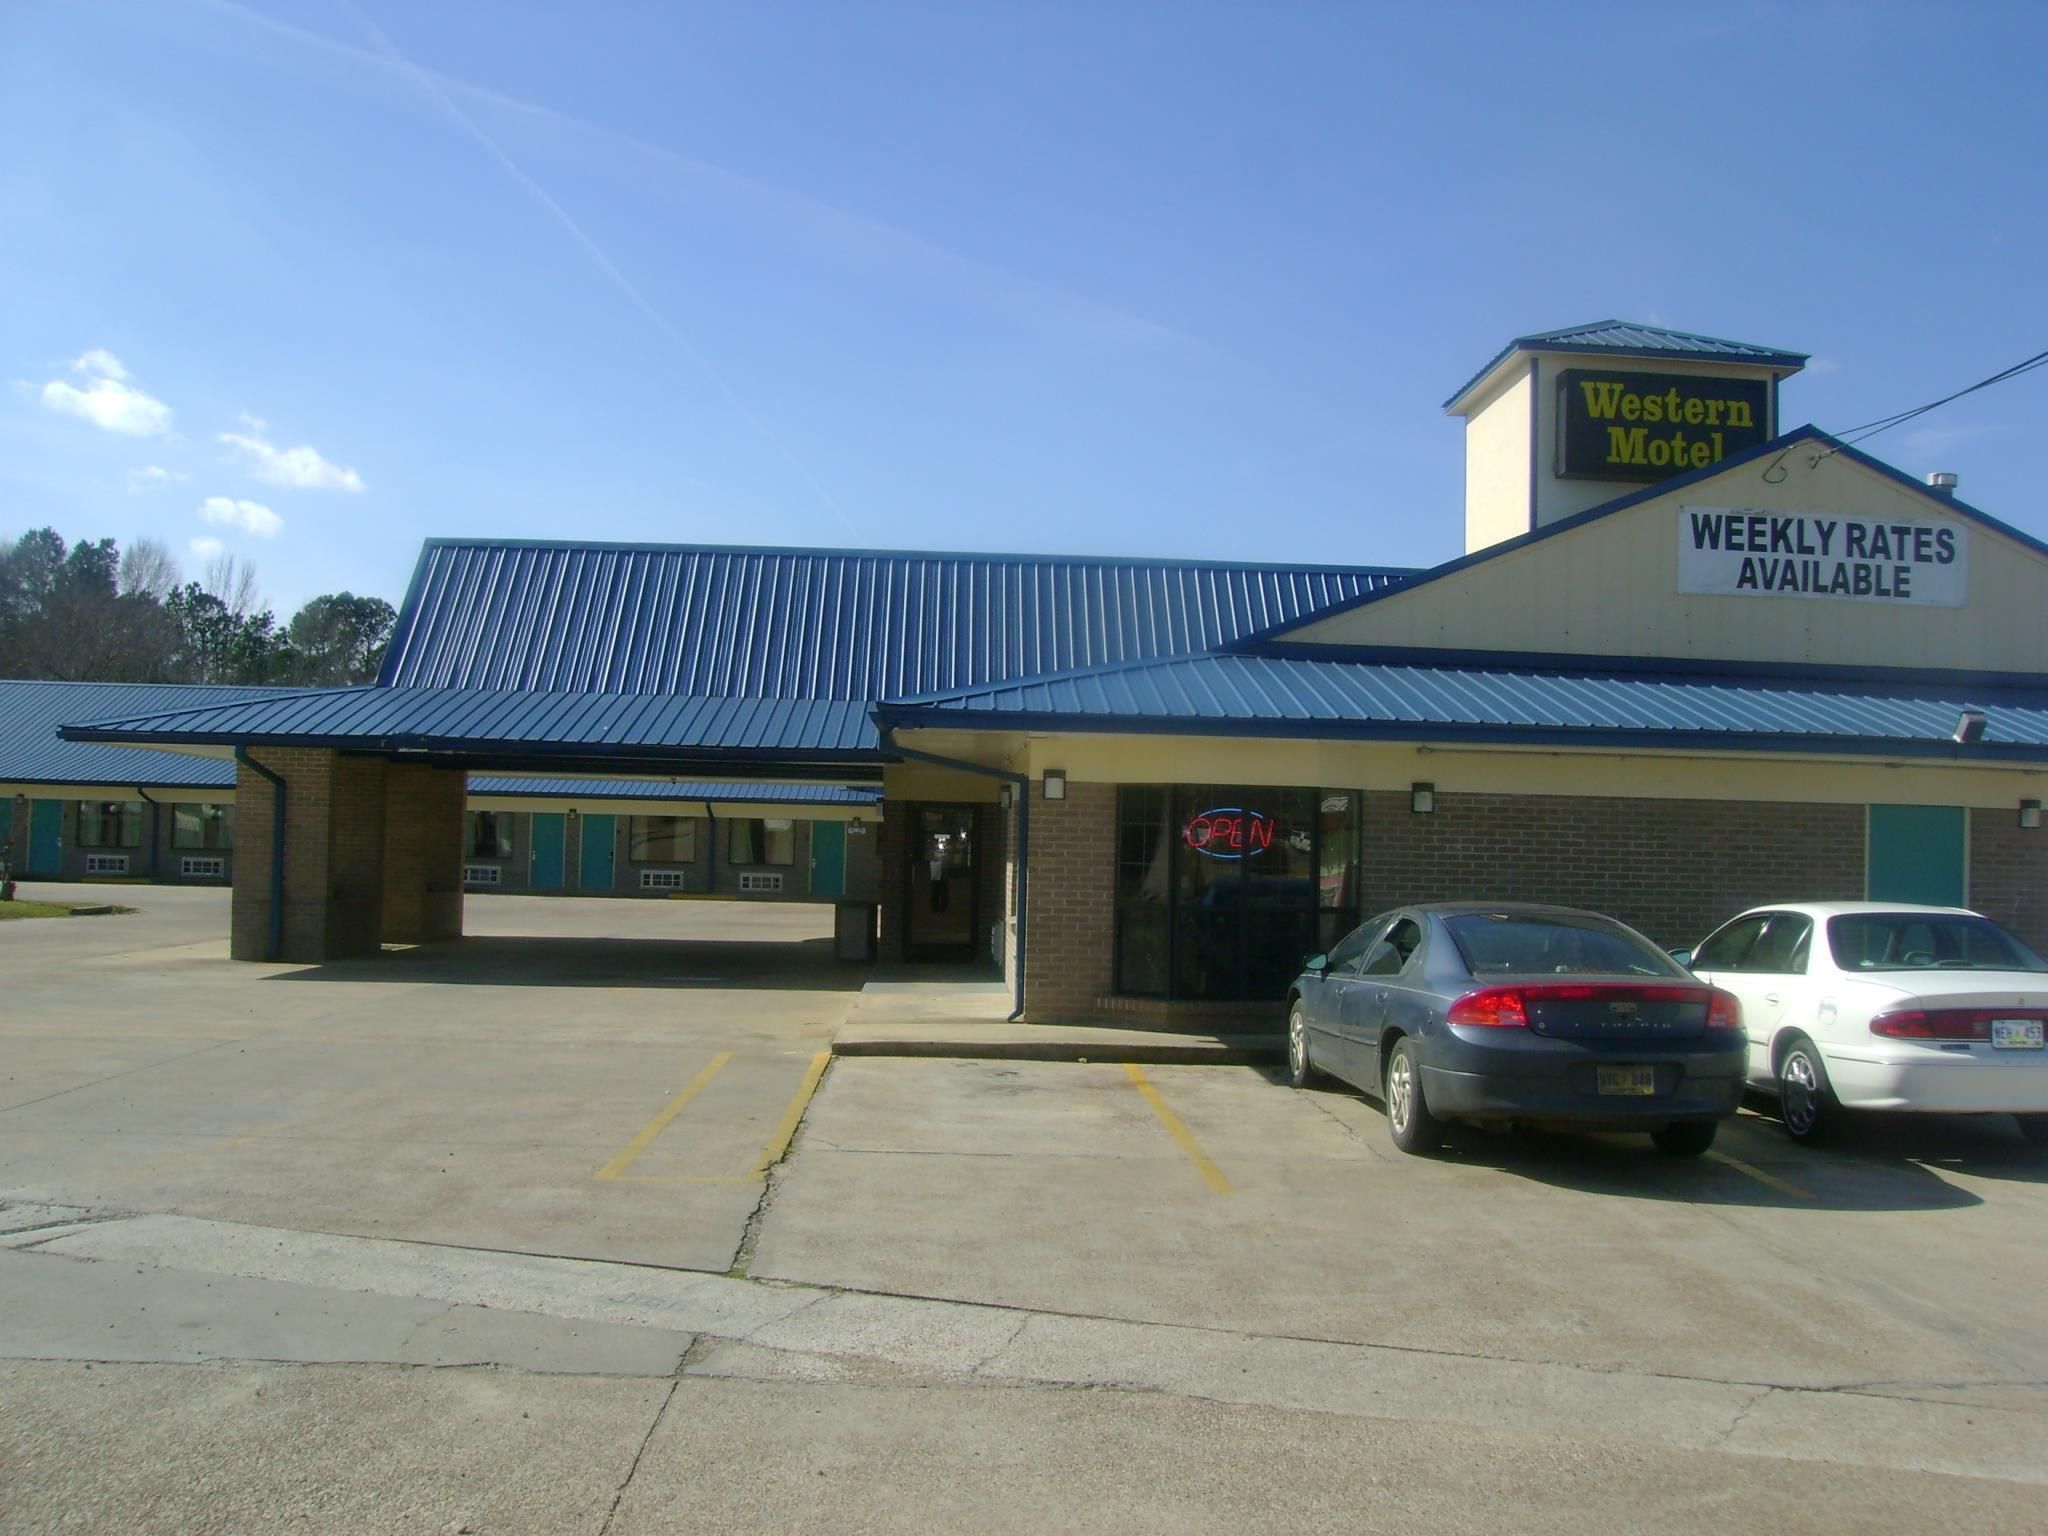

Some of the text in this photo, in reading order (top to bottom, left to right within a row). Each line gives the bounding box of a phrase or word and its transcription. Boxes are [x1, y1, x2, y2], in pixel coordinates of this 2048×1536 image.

[1580, 381, 1752, 427] Western
[1606, 427, 1723, 468] Motel
[1691, 513, 1955, 564] WEEKLY RATES
[1736, 557, 1911, 598] AVAILABLE
[1187, 818, 1275, 848] OPEN
